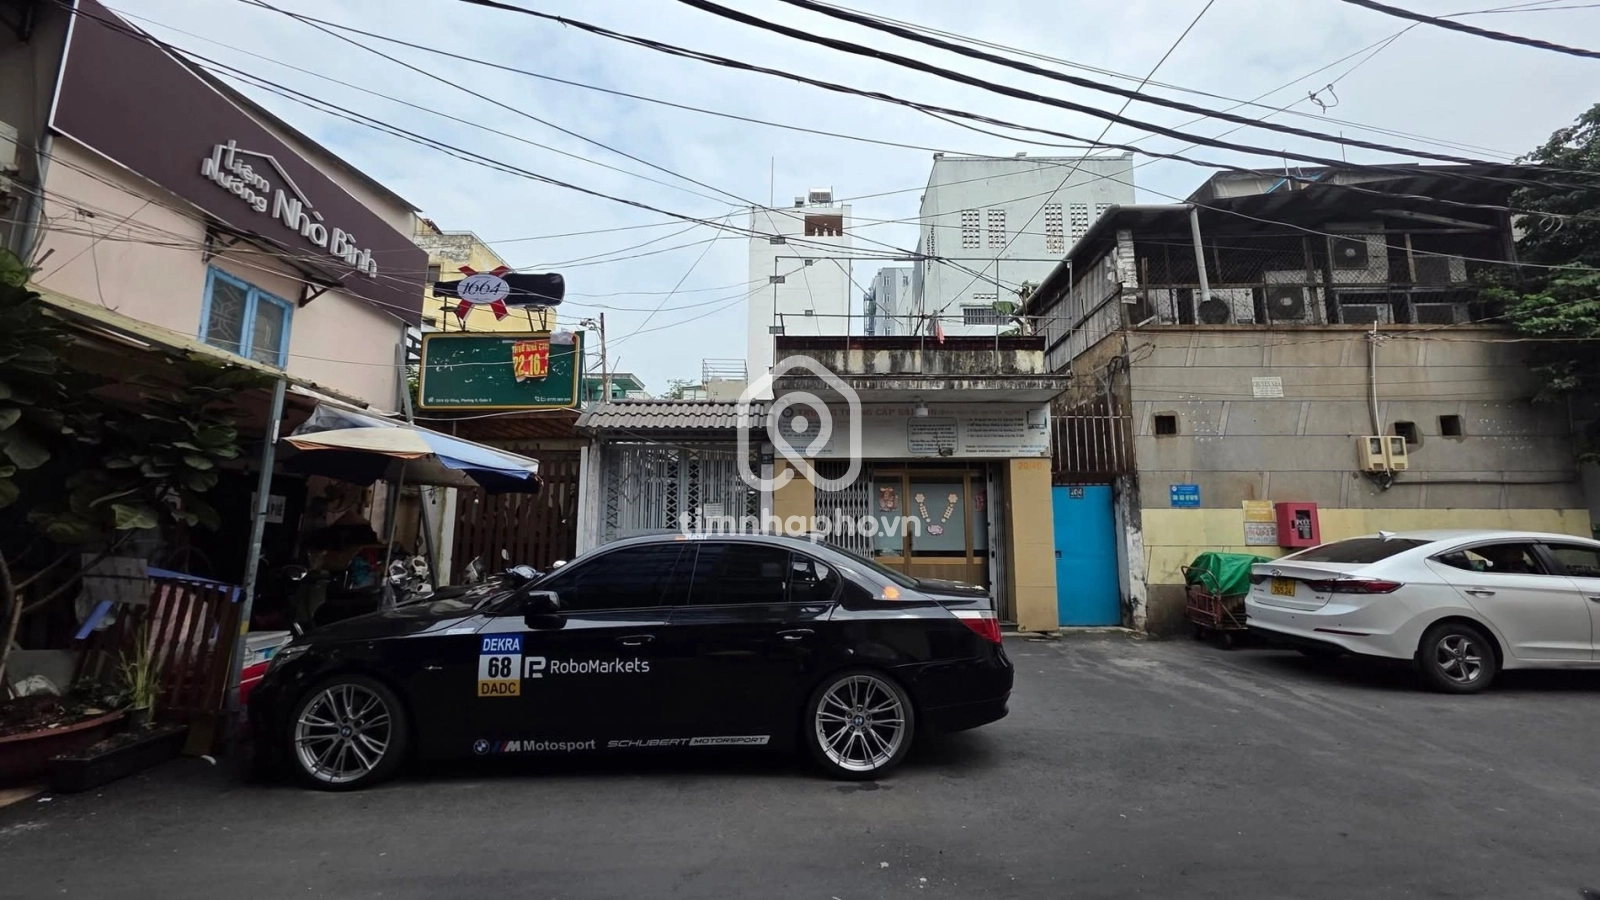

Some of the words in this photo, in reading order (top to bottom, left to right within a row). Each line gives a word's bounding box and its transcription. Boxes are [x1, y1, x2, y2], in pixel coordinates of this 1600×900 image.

[272, 189, 328, 247] Nhà
[329, 227, 378, 278] Bình
[462, 280, 502, 295] 1664
[482, 638, 520, 651] DEKRA
[488, 656, 512, 678] 68
[550, 657, 650, 674] RoboMarkets
[481, 682, 517, 695] DADC
[523, 739, 596, 752] Motosport
[607, 738, 690, 748] SCHUBERT
[693, 736, 766, 745] MOTORSPORT
